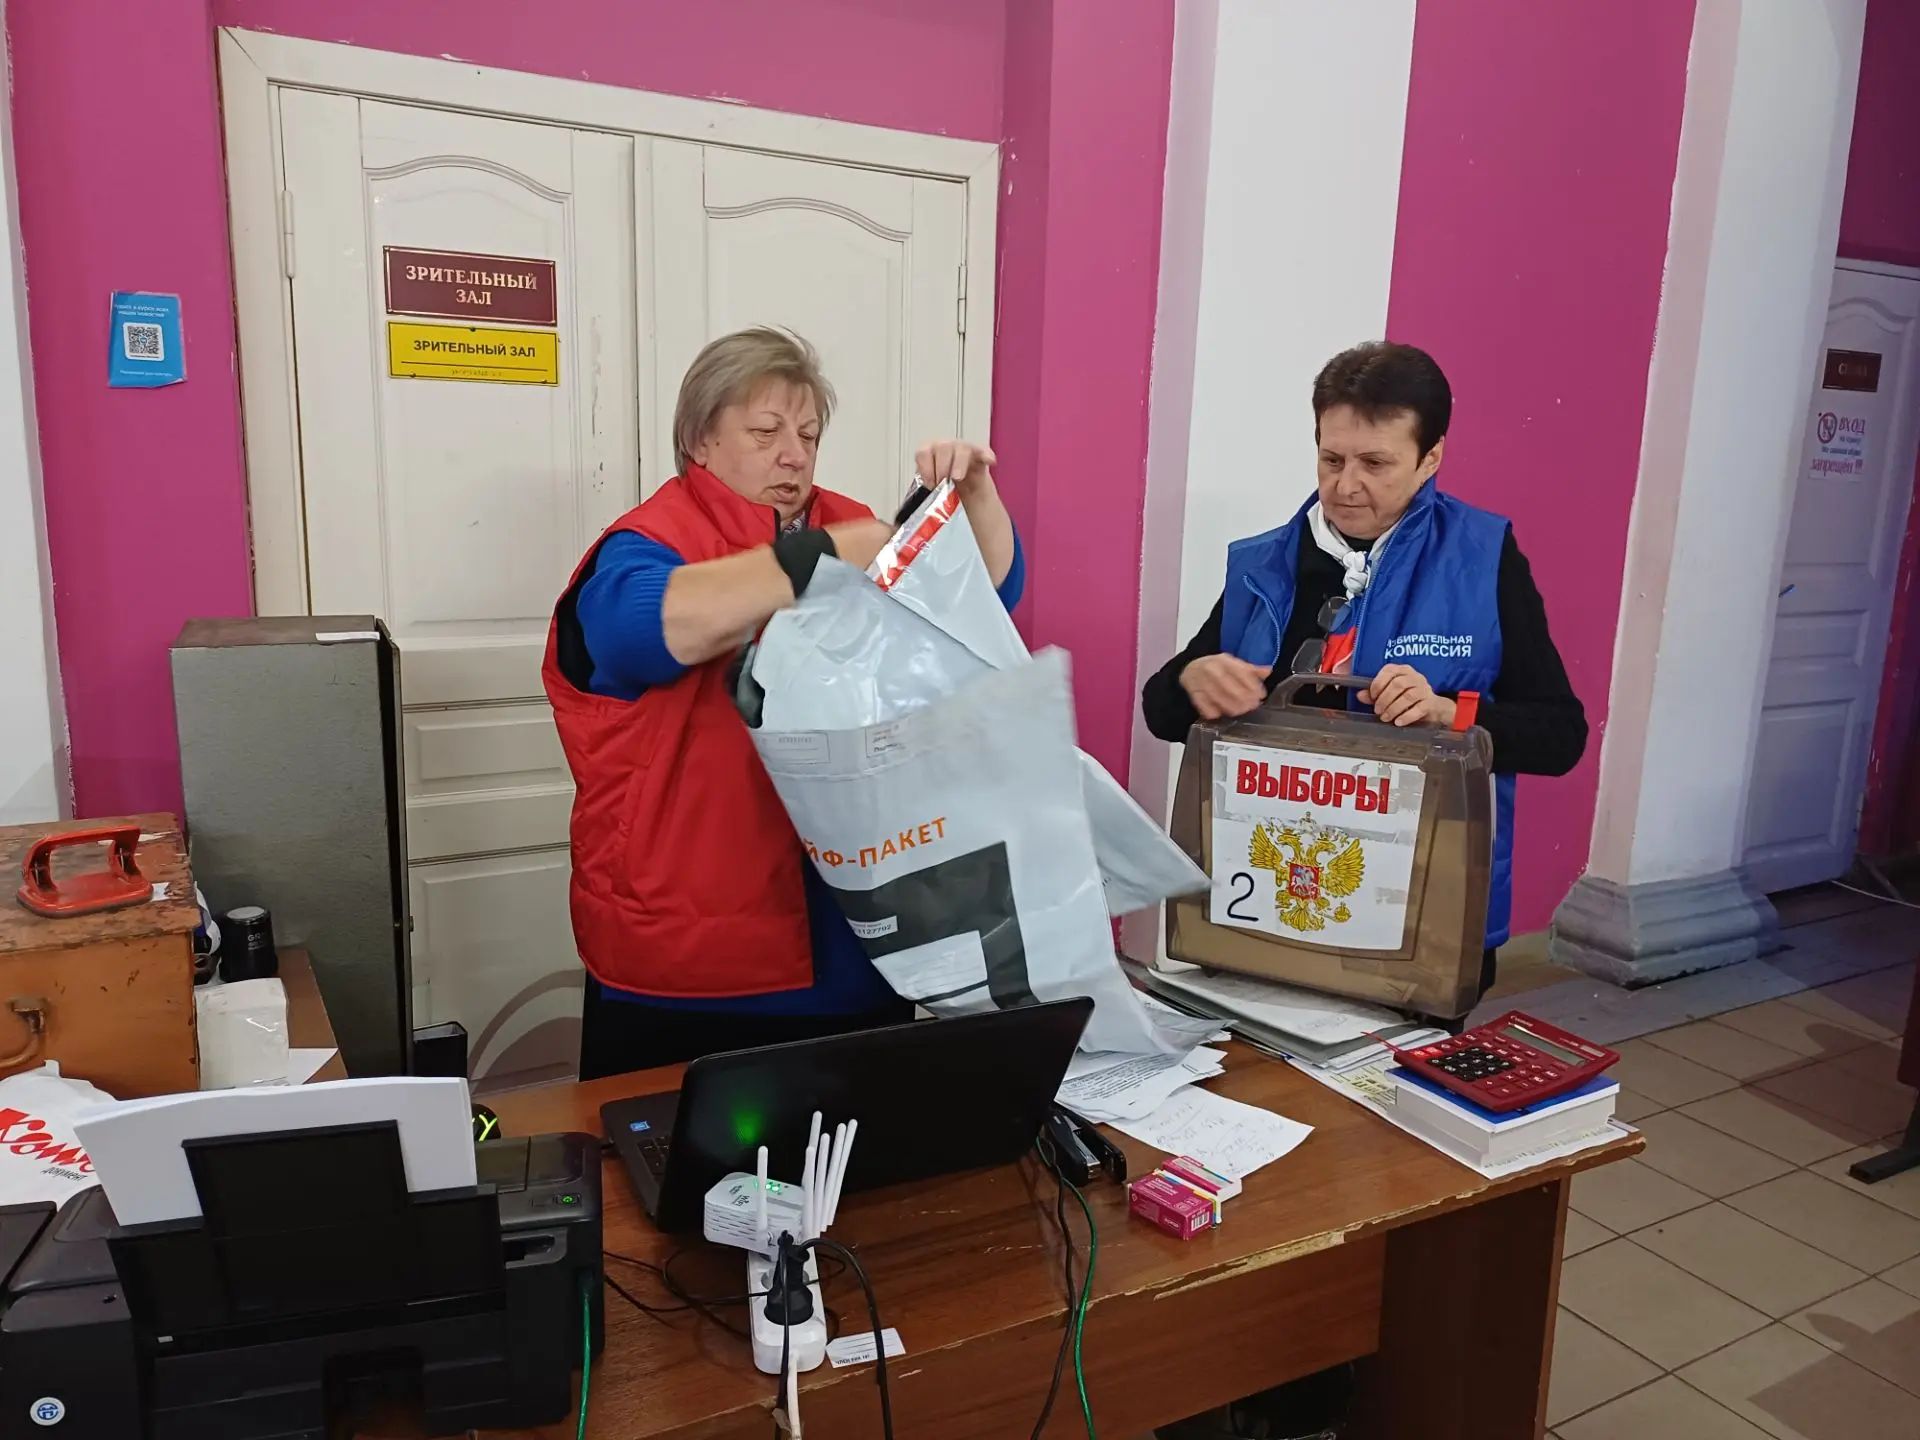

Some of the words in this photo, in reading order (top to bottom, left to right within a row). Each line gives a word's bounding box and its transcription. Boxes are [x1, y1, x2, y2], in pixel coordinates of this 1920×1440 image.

[405, 265, 538, 290] ЗРИТЕЛЬНЫЙ
[455, 289, 492, 305] ЗАЛ
[413, 340, 507, 356] ЗРИТЕЛЬНЫЙ
[510, 346, 536, 358] ЗАЛ
[1384, 643, 1472, 660] КОМИССИЯ
[1236, 759, 1391, 815] ВЫБОРЫ
[1227, 872, 1259, 922] 2
